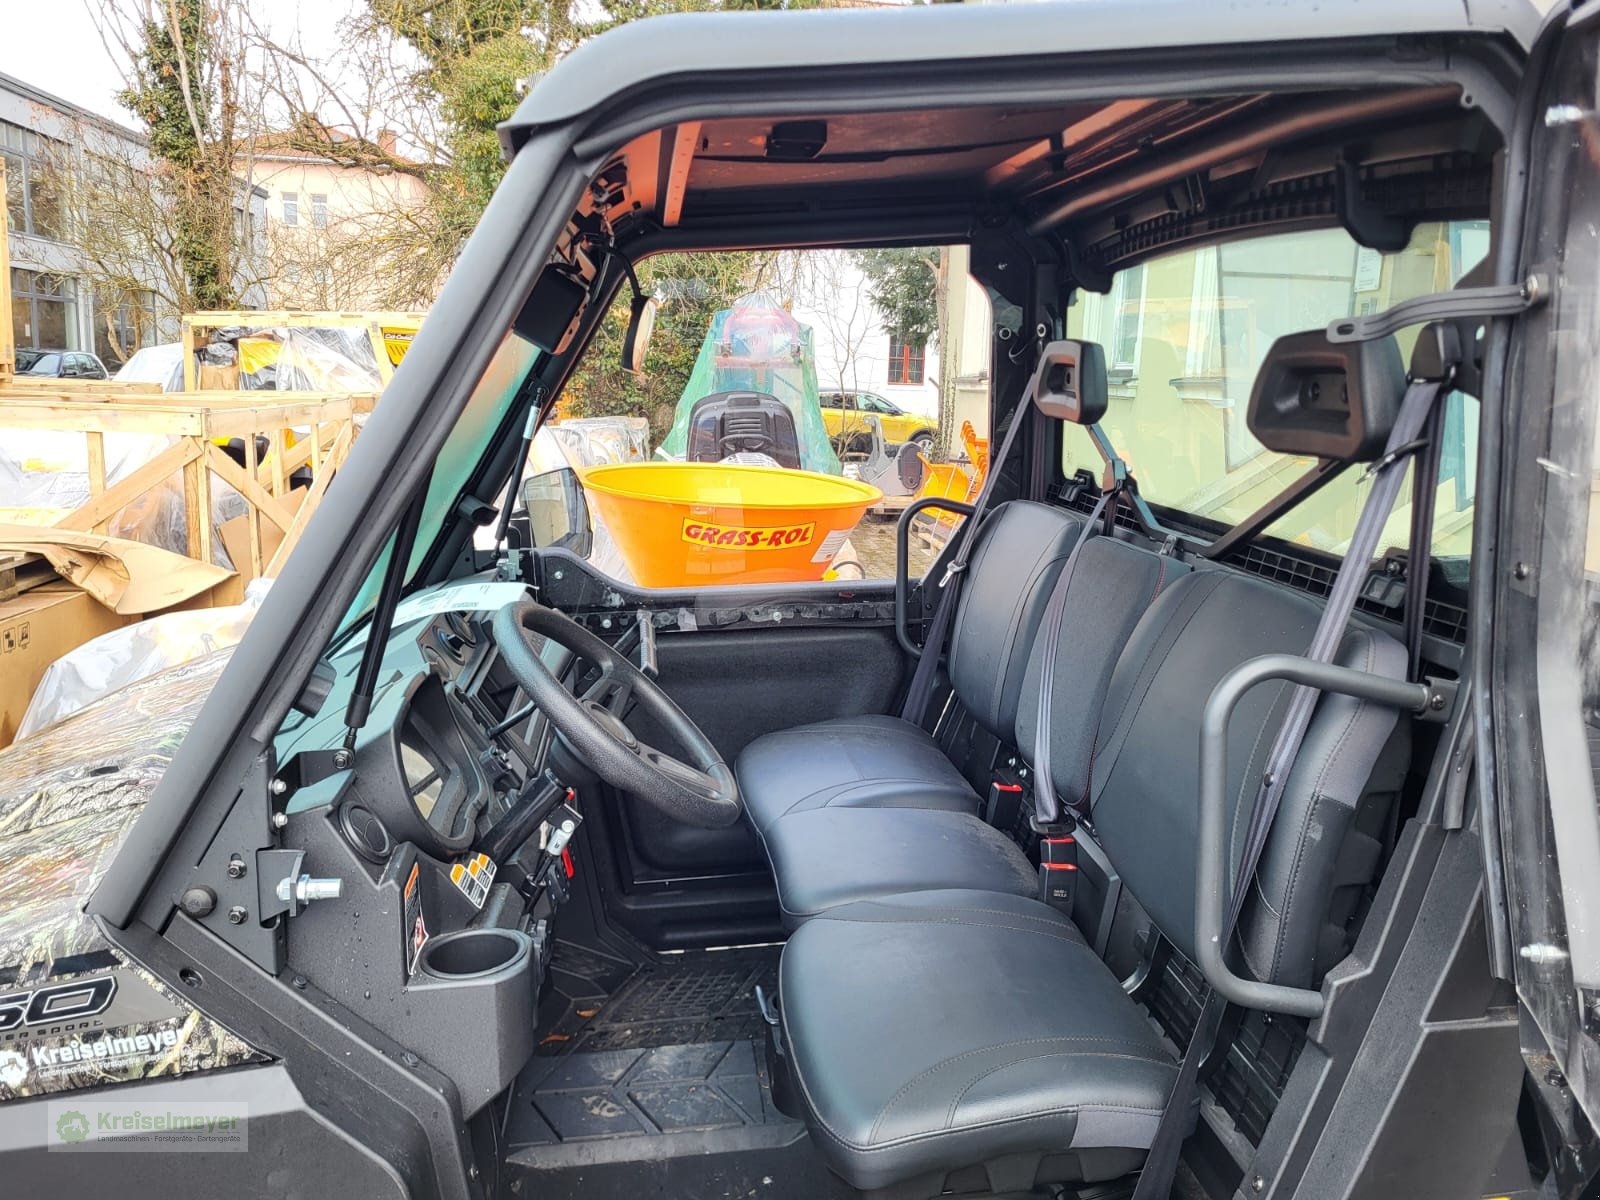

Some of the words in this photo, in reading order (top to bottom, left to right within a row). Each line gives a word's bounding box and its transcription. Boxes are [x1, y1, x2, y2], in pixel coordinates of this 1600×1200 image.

[685, 524, 811, 547] GRASS-ROL
[0, 1032, 29, 1041] ER
[37, 1020, 103, 1035] SPORT
[32, 1028, 186, 1066] Kreiselmeyer
